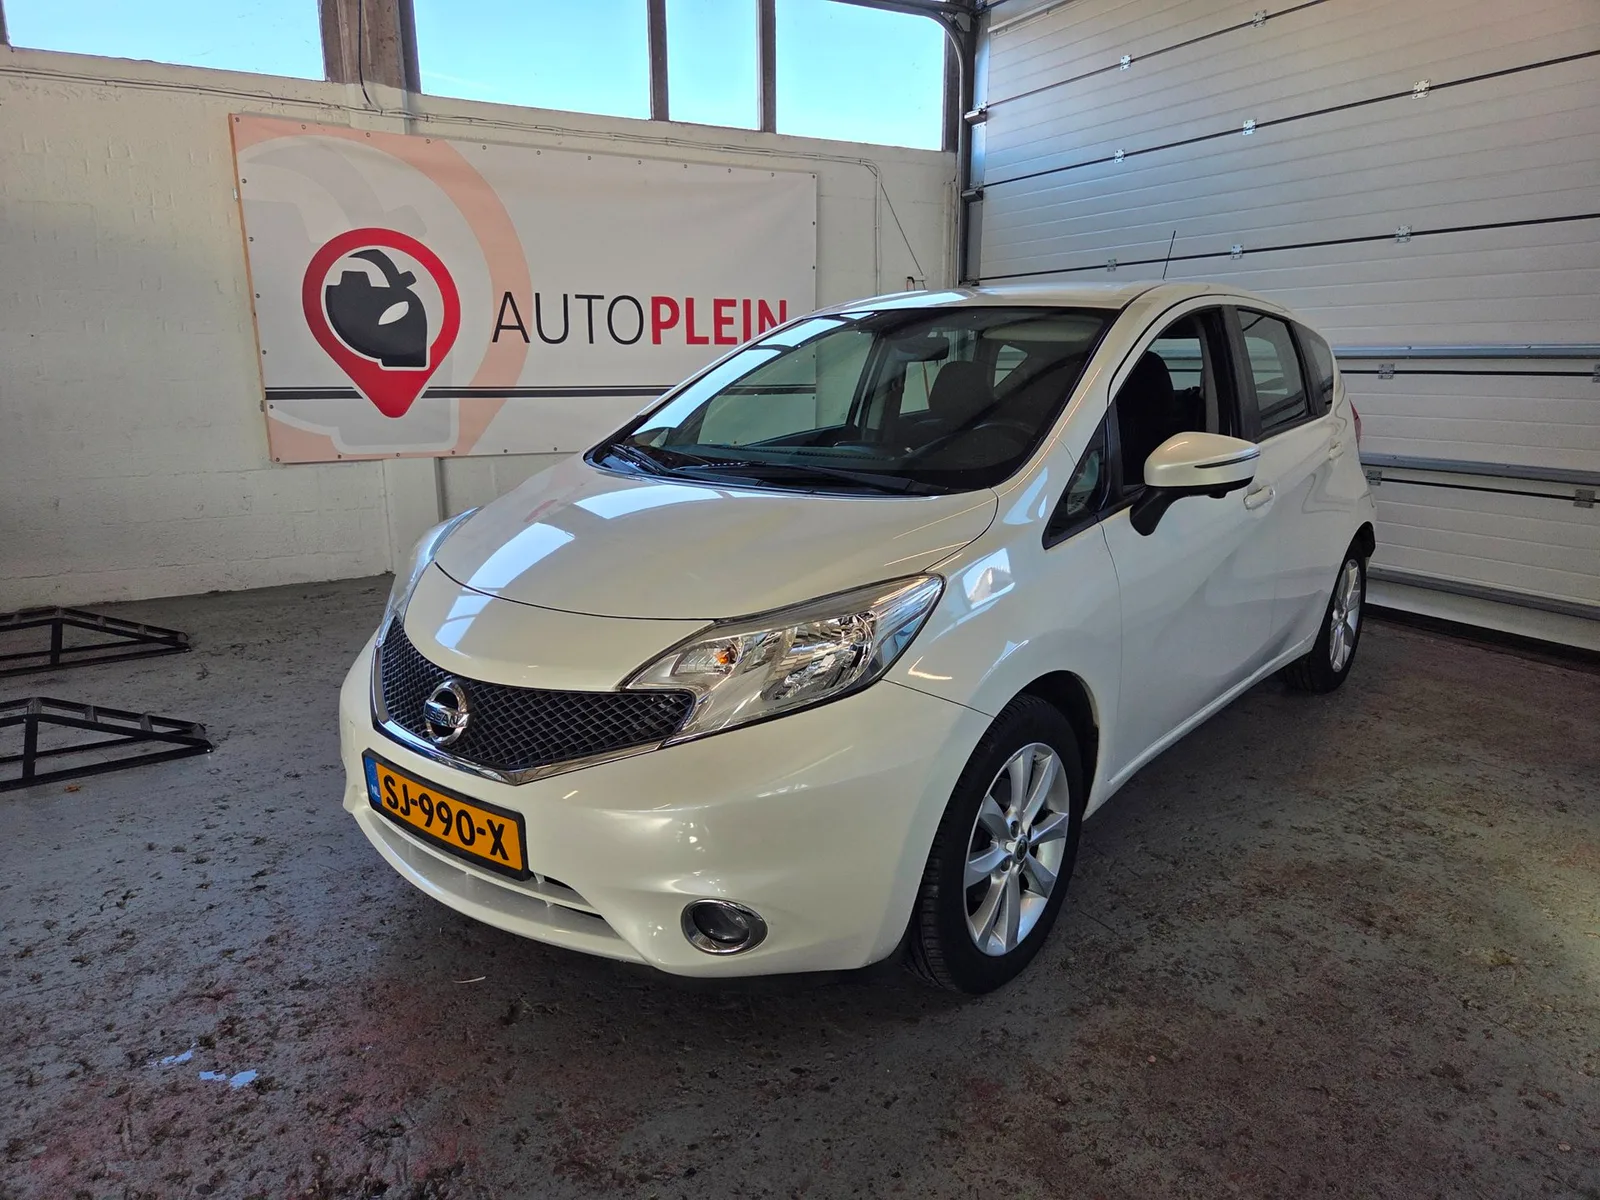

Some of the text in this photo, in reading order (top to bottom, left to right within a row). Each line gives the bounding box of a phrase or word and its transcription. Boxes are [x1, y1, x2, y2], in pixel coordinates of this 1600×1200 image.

[492, 291, 787, 345] AUTOPLEIN
[425, 707, 457, 726] SSAN
[370, 783, 381, 798] NL
[383, 774, 510, 861] SJ-990-X
